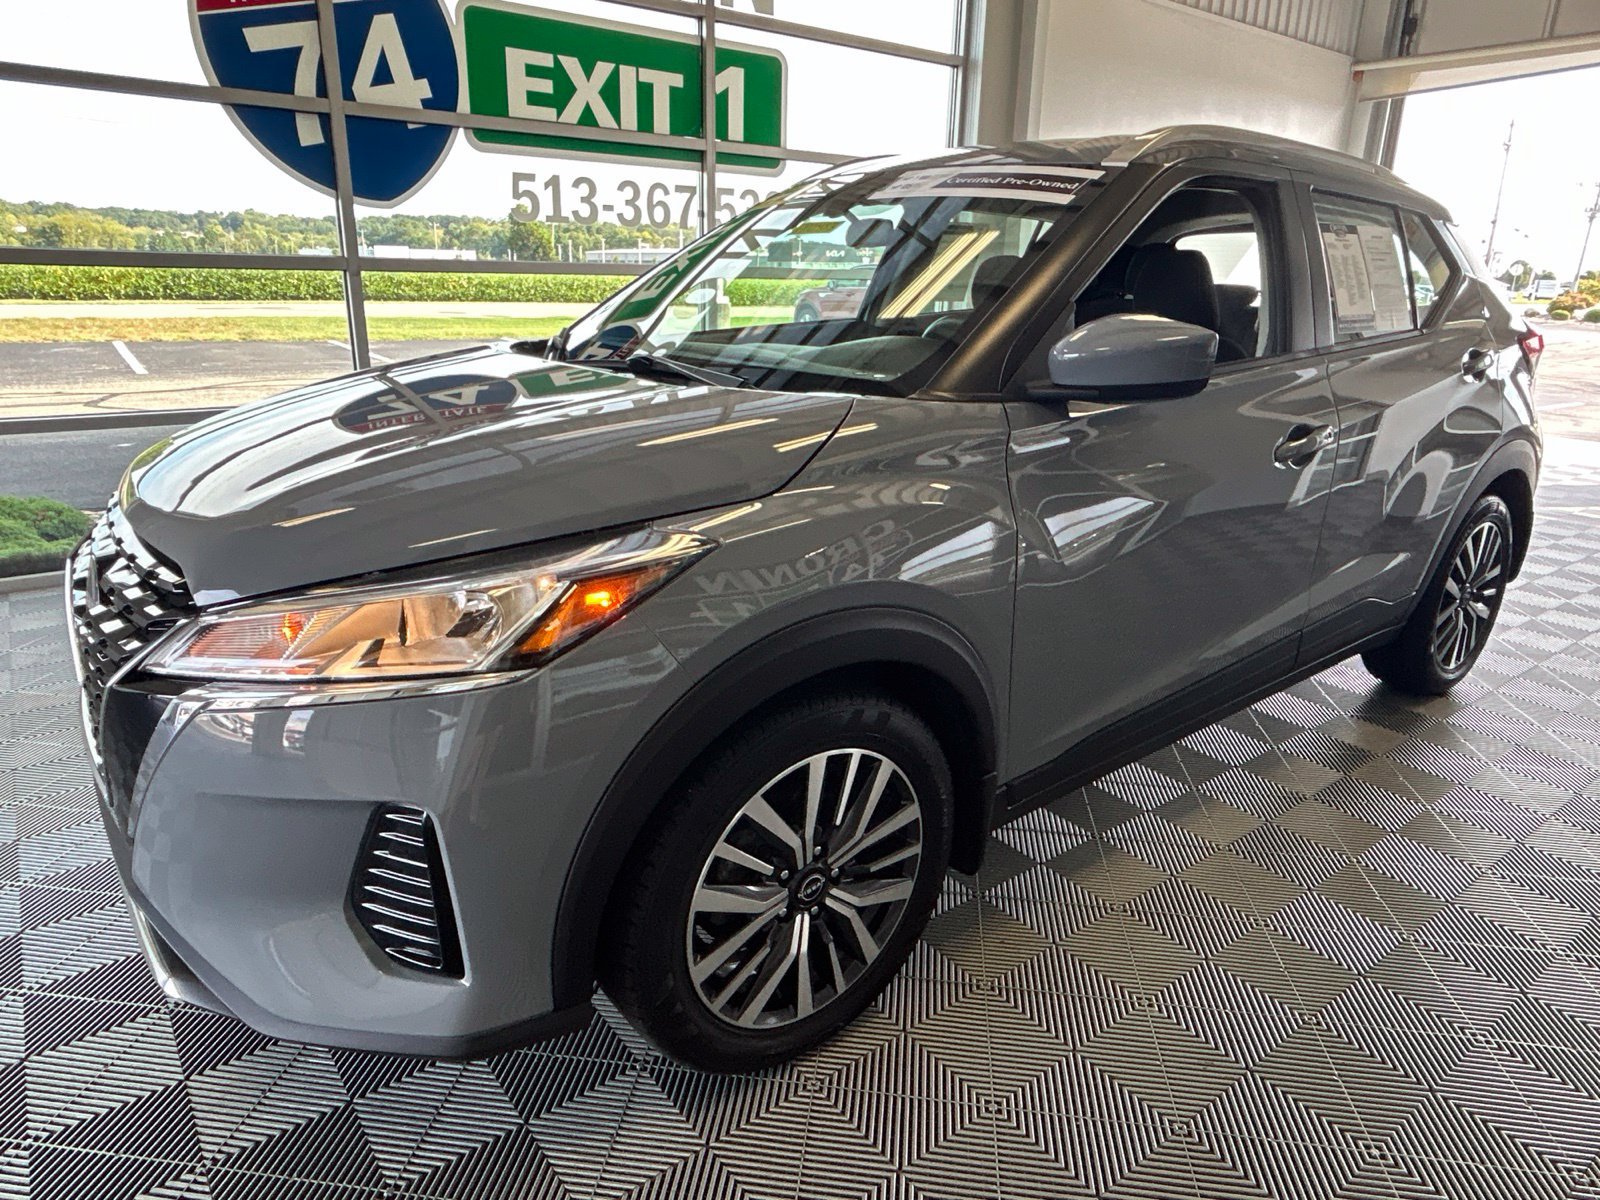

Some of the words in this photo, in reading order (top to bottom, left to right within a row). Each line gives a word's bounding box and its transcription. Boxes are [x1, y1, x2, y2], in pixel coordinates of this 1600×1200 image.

[242, 13, 433, 147] 74
[504, 45, 684, 135] EXIT
[714, 66, 745, 142] 1
[946, 177, 1001, 185] Certified
[1002, 177, 1080, 190] Pre-Owned
